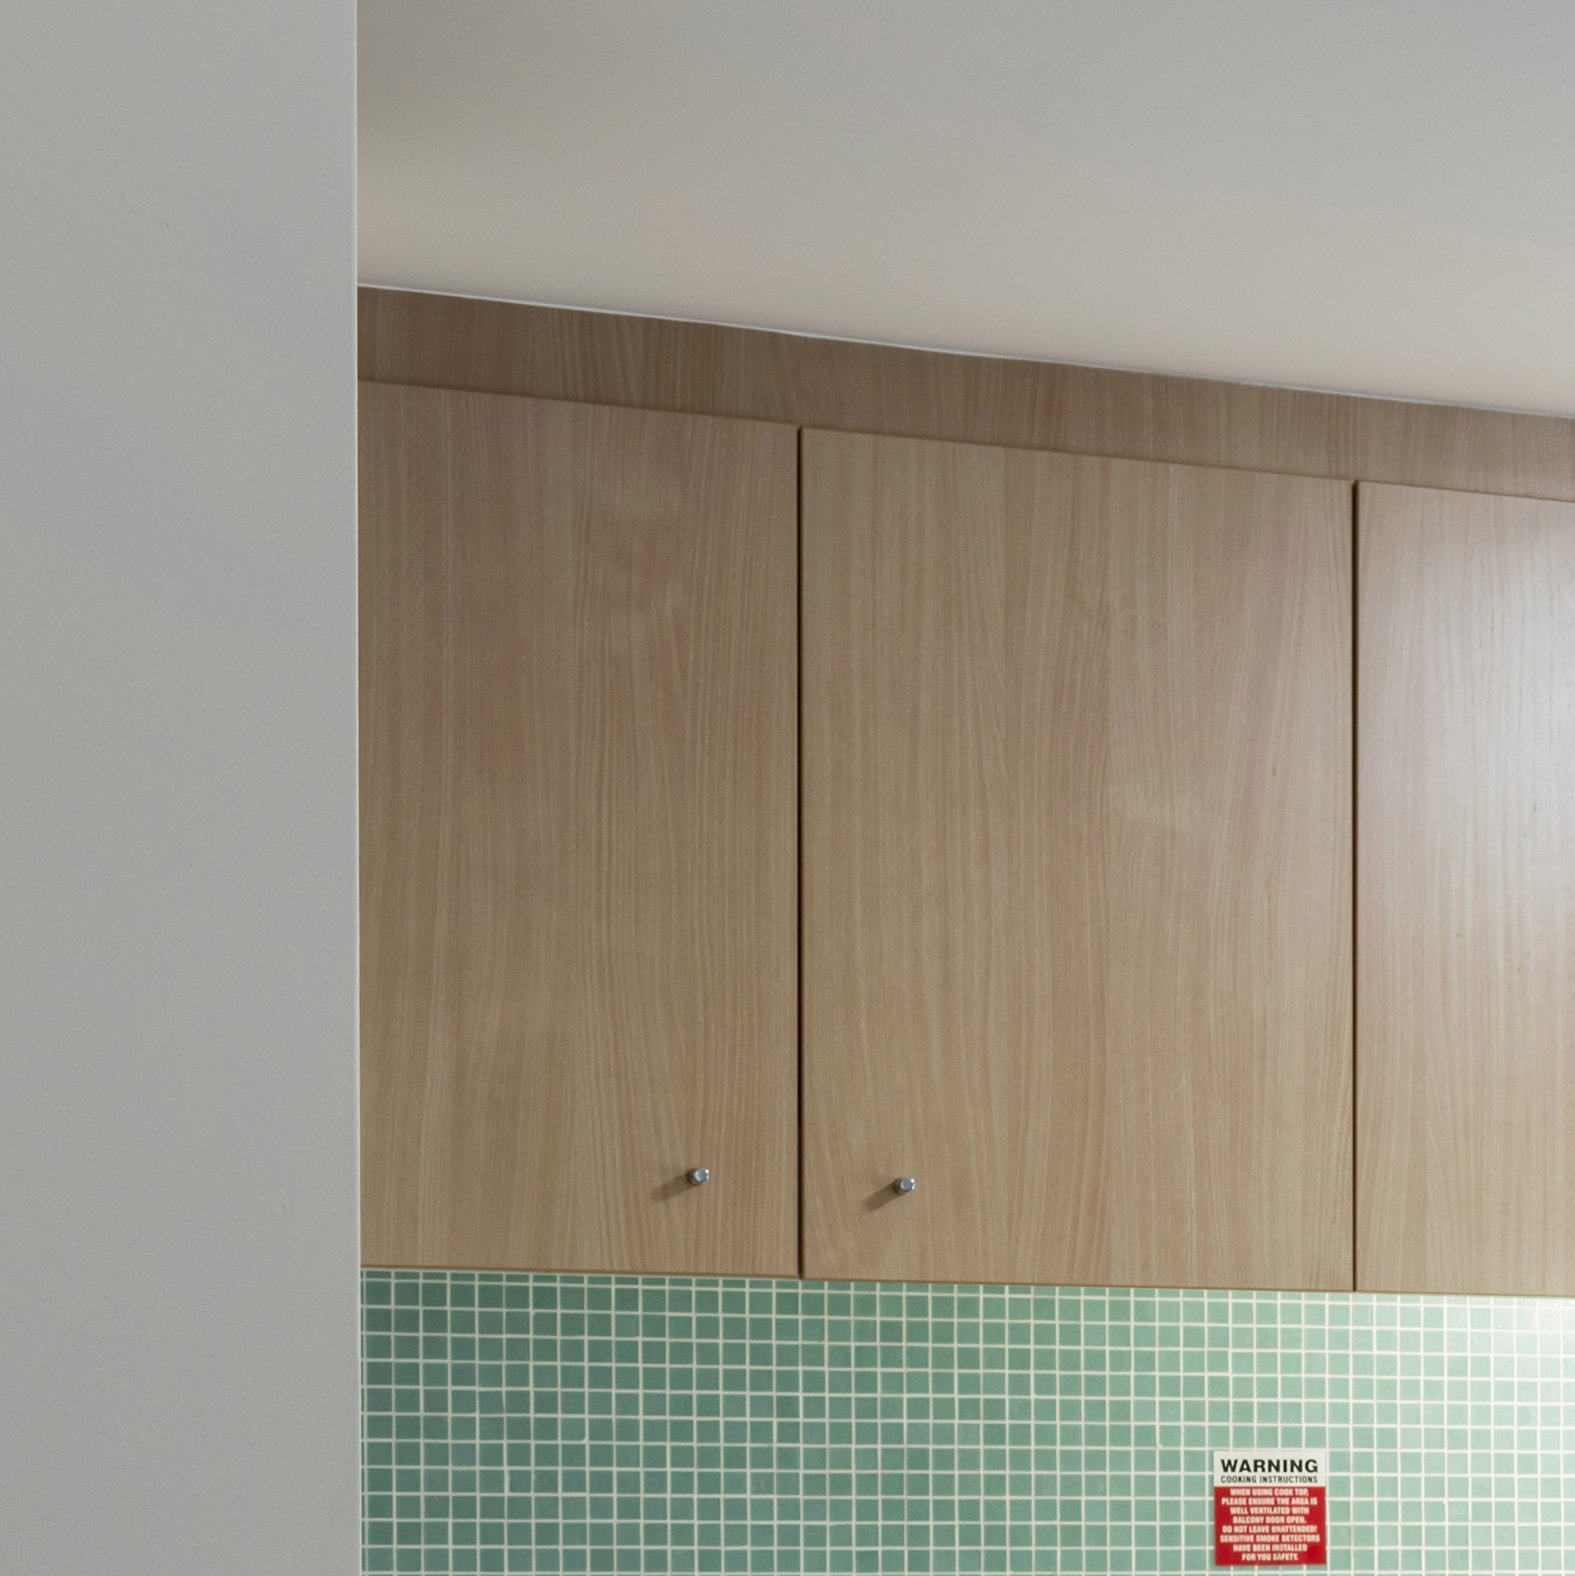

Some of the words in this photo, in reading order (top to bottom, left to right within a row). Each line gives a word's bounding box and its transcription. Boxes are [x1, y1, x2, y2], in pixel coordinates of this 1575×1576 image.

[1221, 1459, 1318, 1473] WARNING
[1220, 1476, 1257, 1484] COOKING
[1260, 1476, 1318, 1484] INSTRUCTIONS
[1230, 1488, 1251, 1496] WHEN
[1252, 1488, 1273, 1496] USING
[1274, 1488, 1293, 1496] COOK
[1221, 1497, 1247, 1505] PLEASE
[1248, 1497, 1275, 1505] ENSURE
[1276, 1497, 1290, 1505] THE
[1291, 1497, 1309, 1505] AREA
[1310, 1497, 1318, 1505] IS
[1230, 1506, 1249, 1515] WELL
[1250, 1506, 1290, 1515] VENTILATED
[1292, 1506, 1310, 1515] WITH
[1232, 1516, 1264, 1524] BALCONY
[1266, 1516, 1285, 1524] DOOR
[1286, 1516, 1307, 1524] OPEN.
[1222, 1525, 1233, 1533] DO
[1234, 1525, 1248, 1533] NOT
[1248, 1525, 1270, 1533] LEAVE
[1271, 1525, 1318, 1533] UNATTENDED!
[1220, 1534, 1254, 1543] SENSITIVE
[1256, 1534, 1280, 1543] SMOKE
[1281, 1534, 1320, 1543] DETECTORS
[1232, 1544, 1251, 1552] HAVE
[1252, 1544, 1271, 1552] BEEN
[1272, 1544, 1308, 1552] INSTALLED
[1242, 1553, 1256, 1561] FOR
[1257, 1553, 1272, 1561] YOU
[1272, 1553, 1299, 1561] SAFETY.
